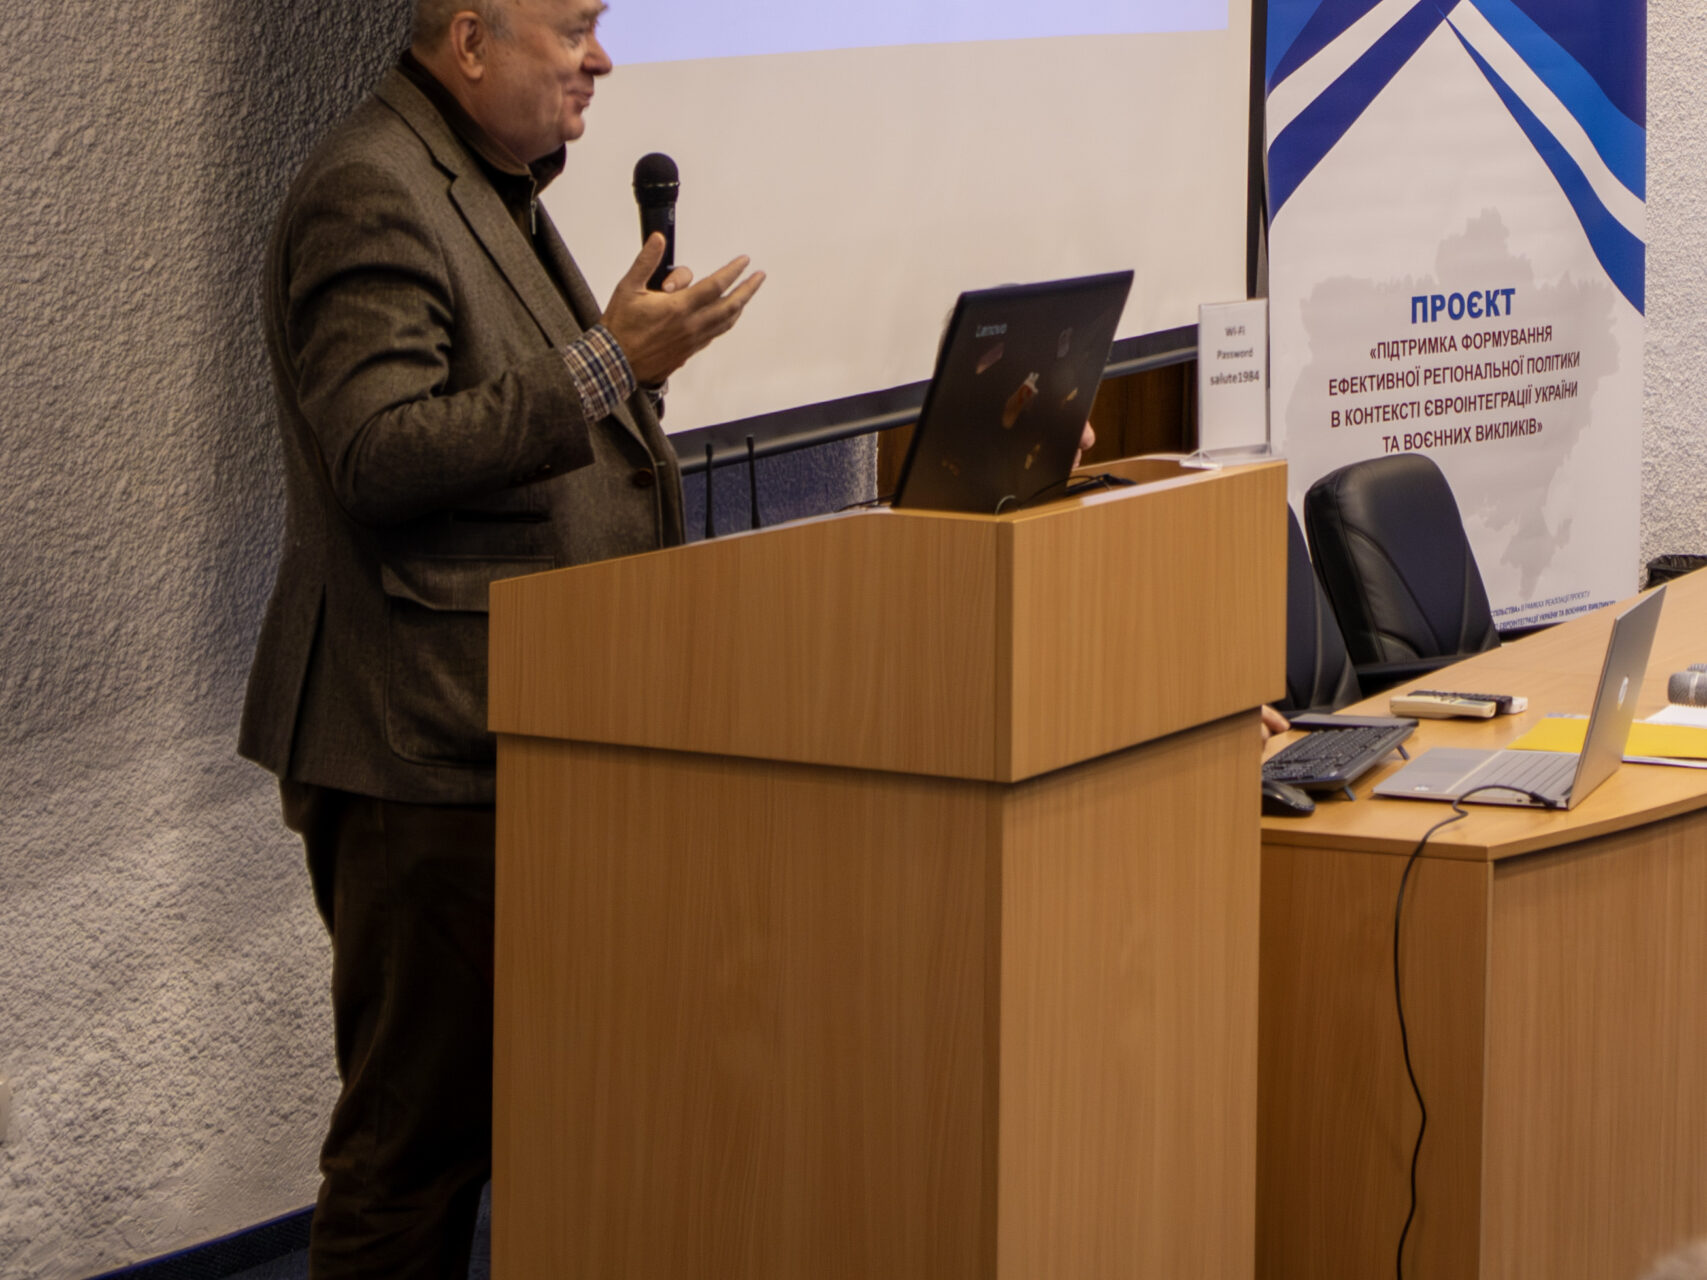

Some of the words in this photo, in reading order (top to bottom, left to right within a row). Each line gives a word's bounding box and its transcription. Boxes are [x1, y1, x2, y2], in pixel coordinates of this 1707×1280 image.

[1411, 288, 1516, 325] ПРОЄКТ
[1217, 347, 1253, 360] Password
[1369, 336, 1457, 362] «ПІДТРИМКА
[1461, 325, 1553, 352] ФОРМУВАННЯ
[1210, 370, 1259, 386] salute1984
[1328, 366, 1420, 397] ЕФЕКТИВНОЇ
[1424, 358, 1523, 387] РЕГІОНАЛЬНОЇ
[1526, 351, 1580, 375] ПОЛІТИКИ
[1330, 410, 1341, 428] В
[1345, 401, 1421, 427] КОНТЕКСТІ
[1424, 384, 1531, 419] ЄВРОІНТЕГРАЦІЇ
[1535, 380, 1578, 403] УКРАЇНИ
[1382, 435, 1400, 454] ТА
[1403, 426, 1472, 451] ВОЄННИХ
[1476, 418, 1543, 444] ВИКЛИКІВ»
